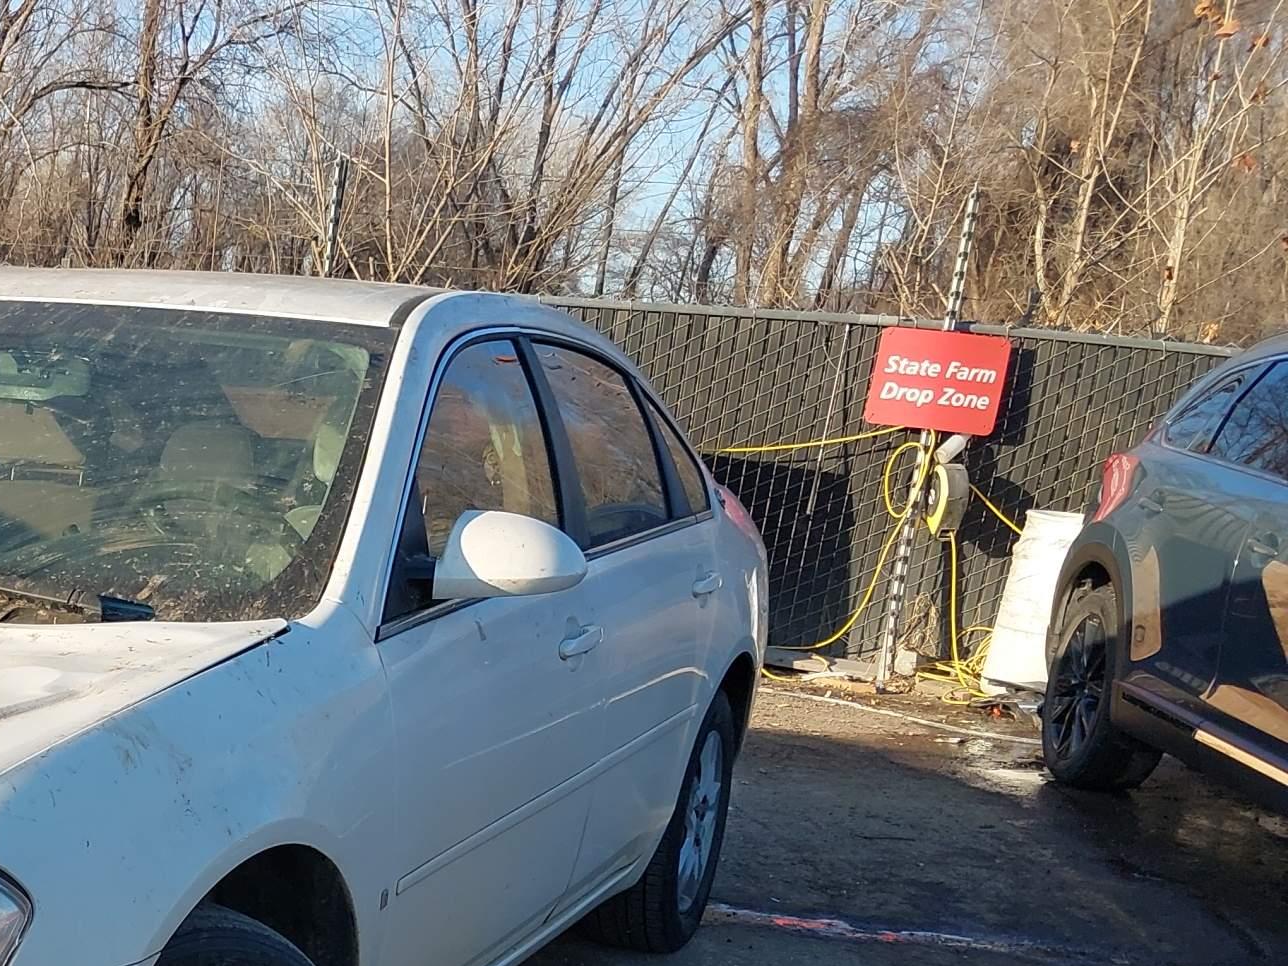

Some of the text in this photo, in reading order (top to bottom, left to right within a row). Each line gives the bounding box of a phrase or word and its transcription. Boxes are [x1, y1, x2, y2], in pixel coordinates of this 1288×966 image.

[884, 355, 997, 384] State Farm
[879, 381, 990, 410] Drop Zone
